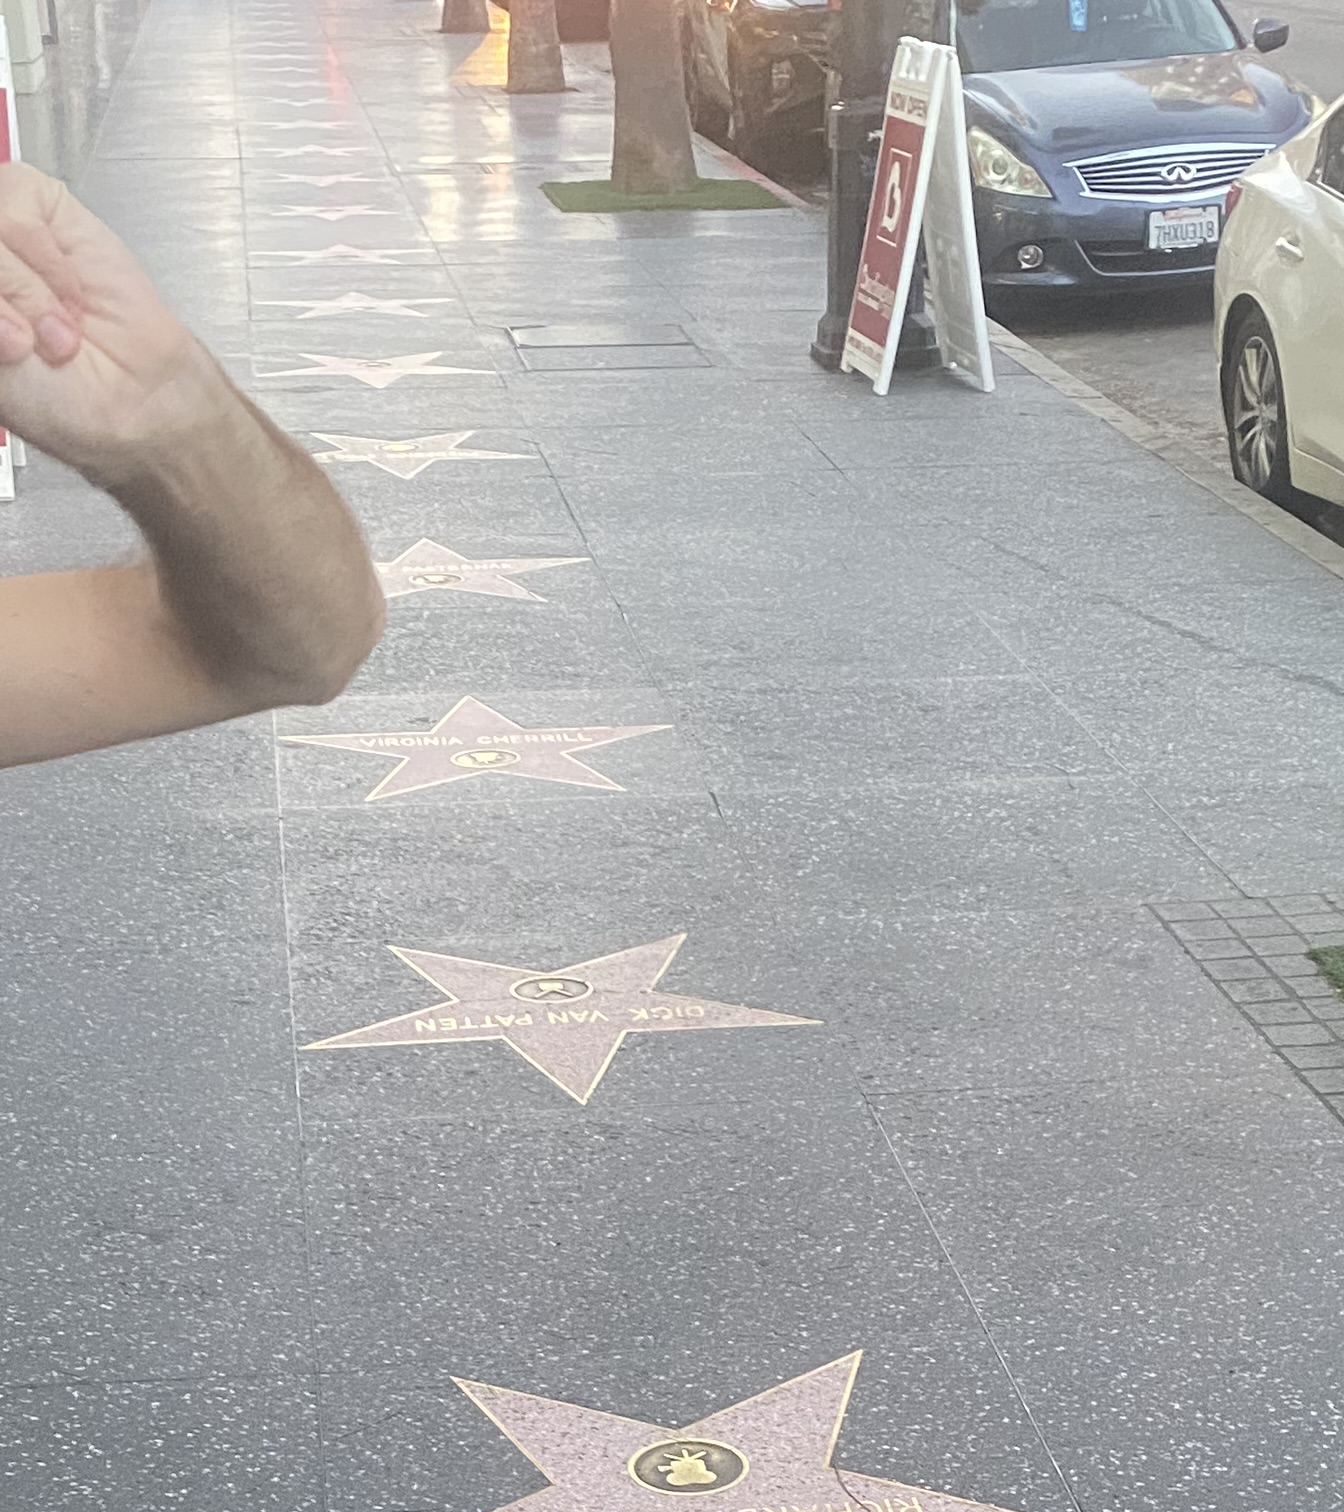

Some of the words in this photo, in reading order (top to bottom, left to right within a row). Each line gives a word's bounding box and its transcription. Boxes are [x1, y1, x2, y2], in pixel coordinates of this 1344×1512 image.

[547, 1008, 610, 1025] VAN
[628, 1005, 705, 1021] DICK
[414, 1013, 534, 1033] PATTEN
